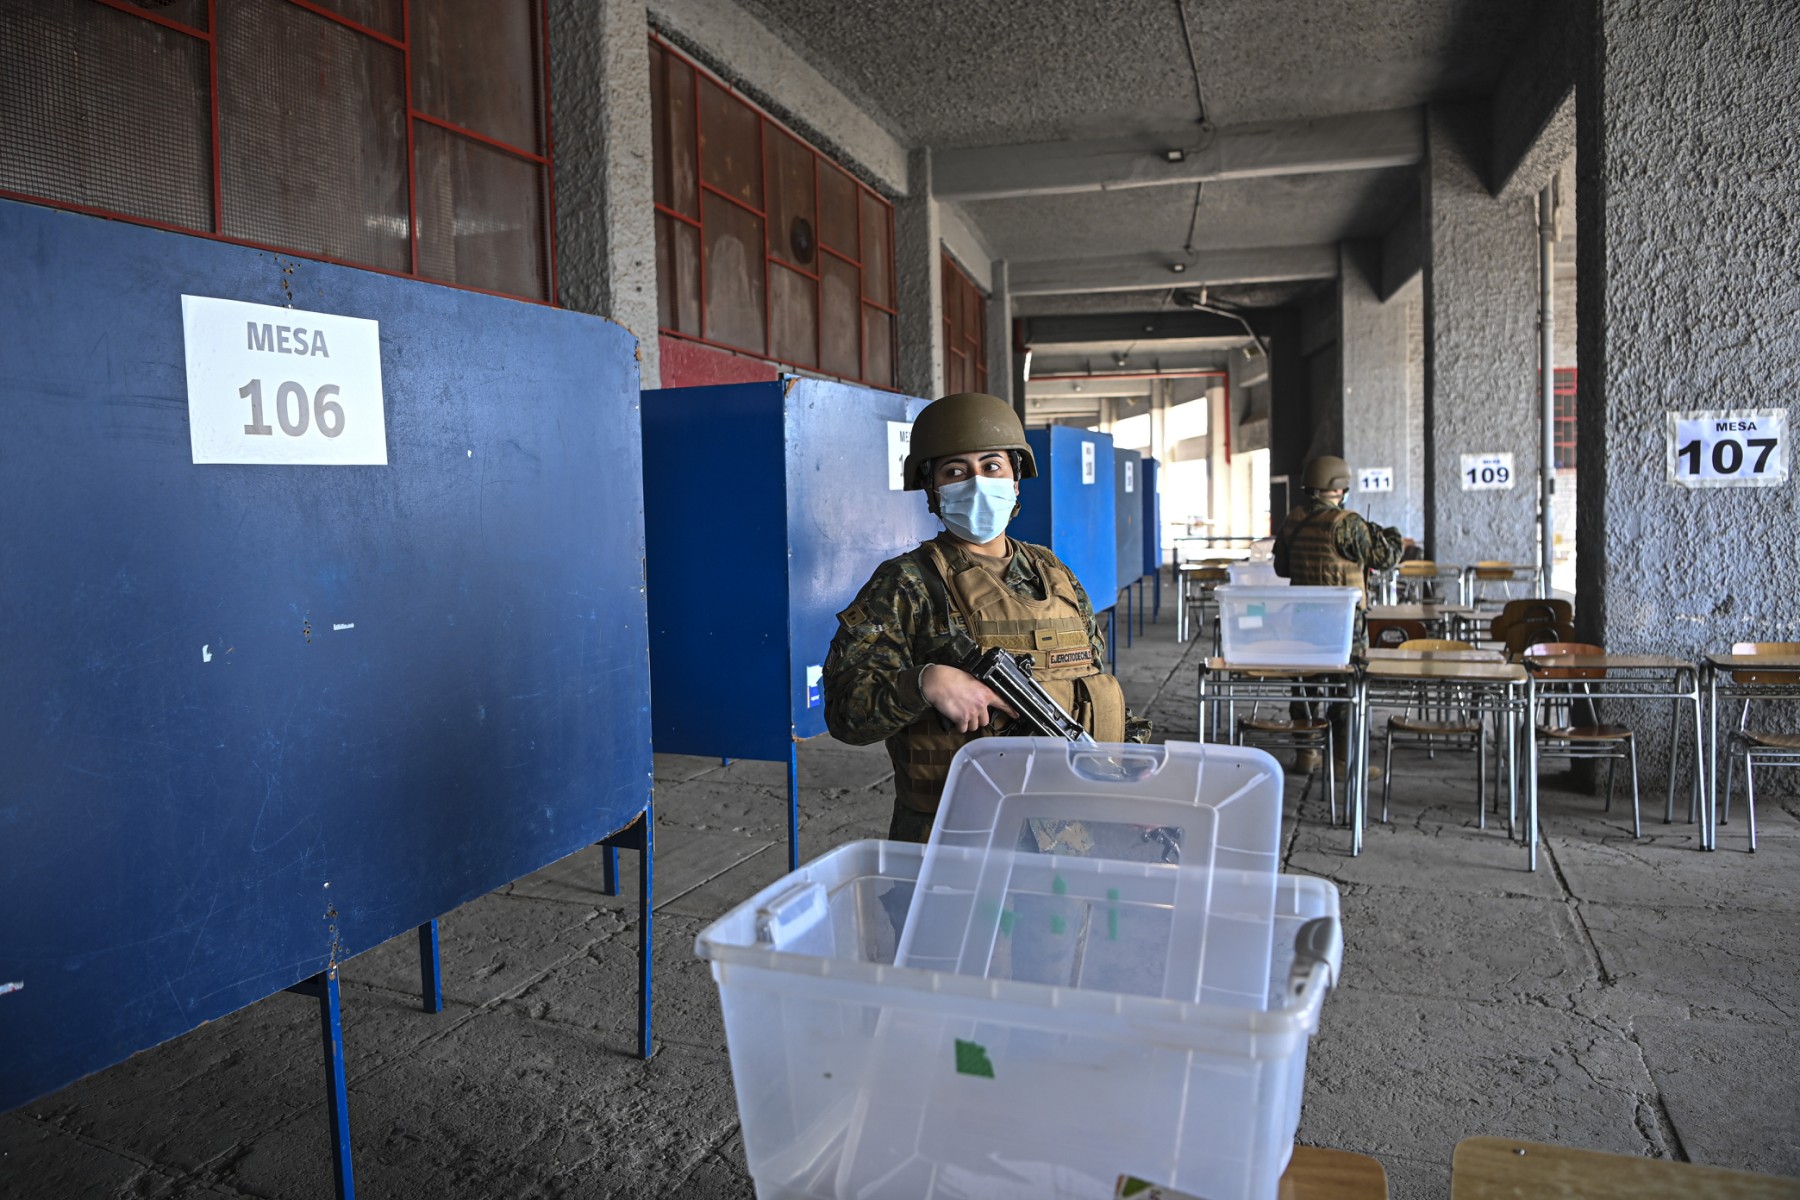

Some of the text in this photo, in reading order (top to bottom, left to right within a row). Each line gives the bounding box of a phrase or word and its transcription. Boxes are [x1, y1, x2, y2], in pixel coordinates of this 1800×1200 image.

[247, 321, 330, 358] MESA
[238, 378, 346, 438] 106
[1716, 421, 1757, 432] MESA
[899, 430, 911, 443] ME
[1678, 438, 1778, 475] 107
[1362, 476, 1389, 488] 111
[1466, 467, 1509, 484] 109
